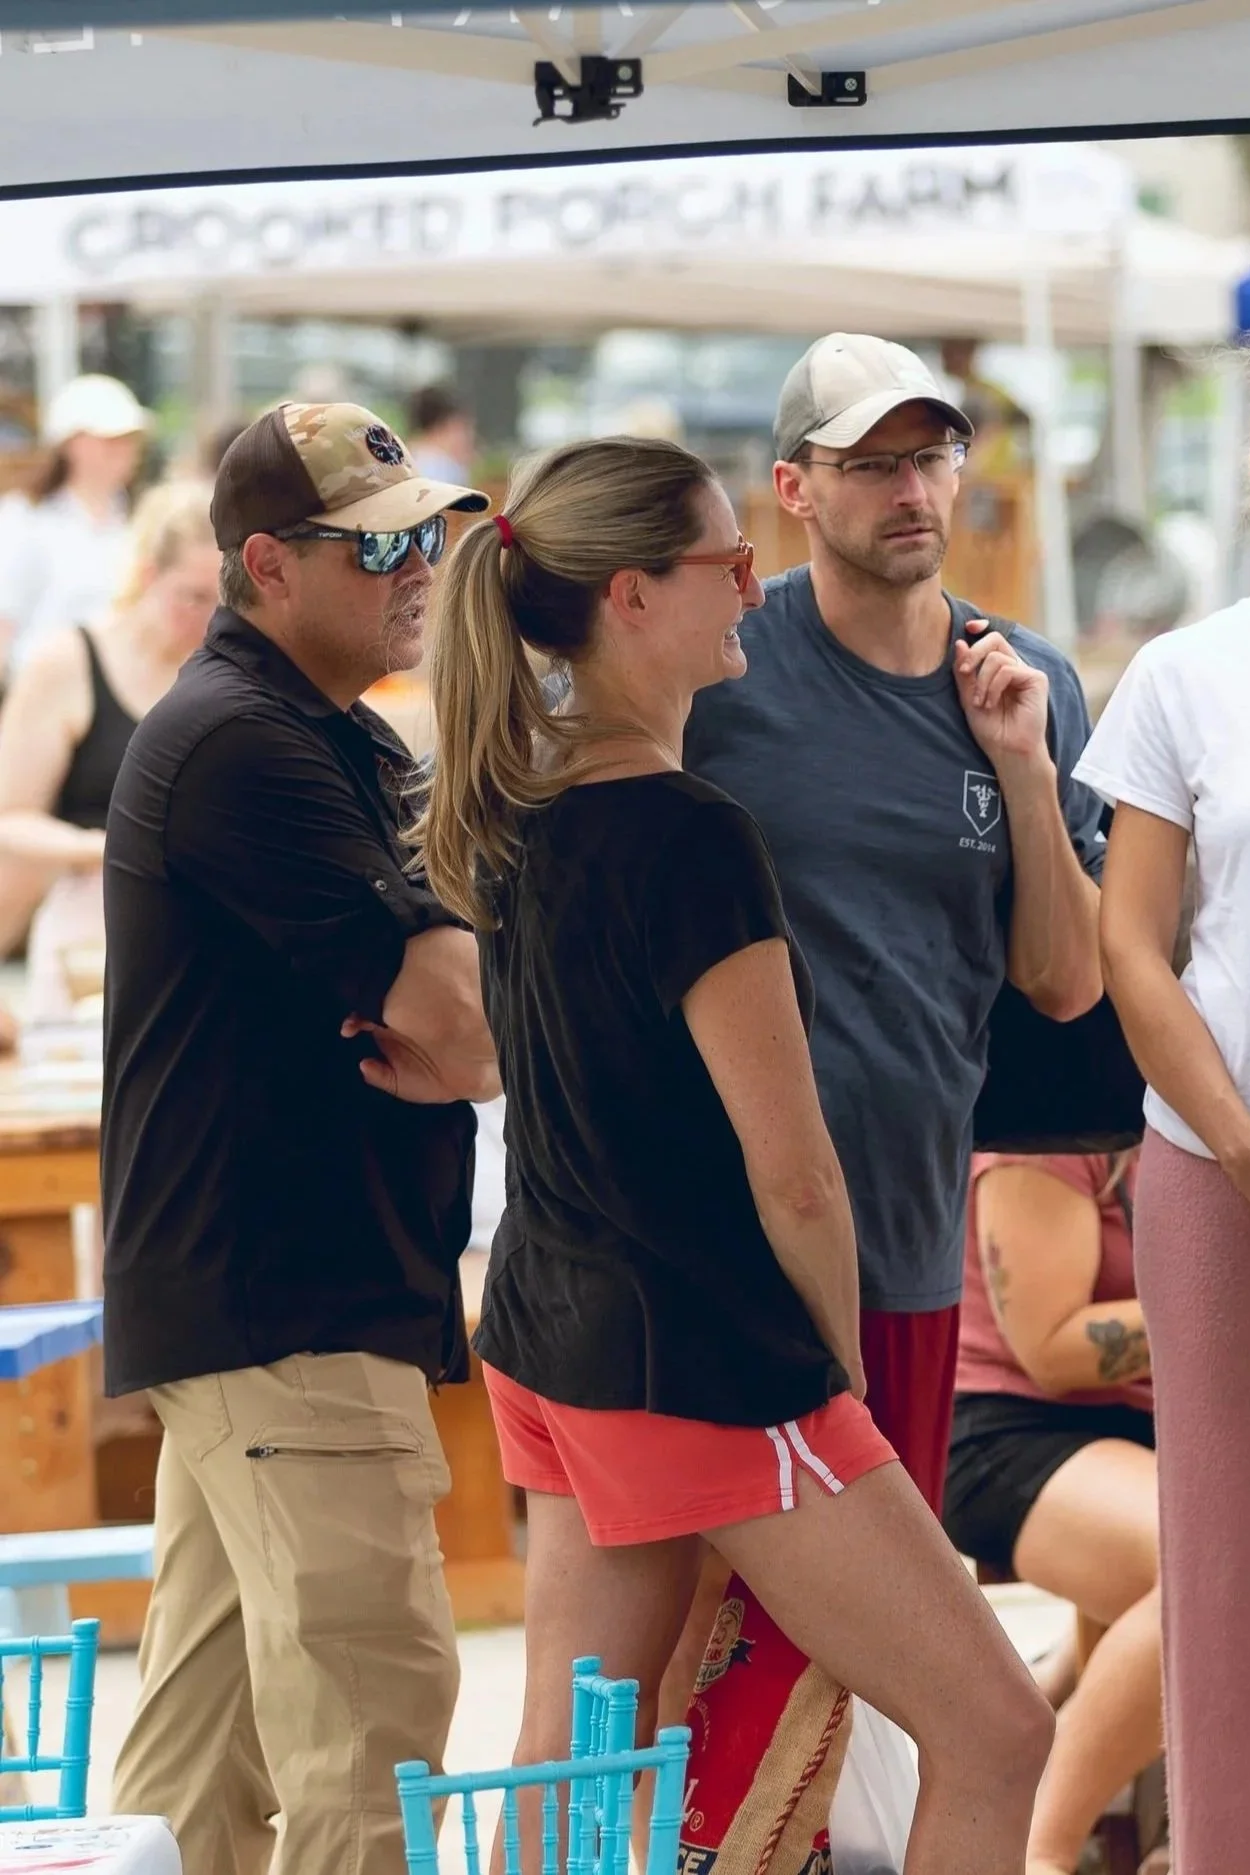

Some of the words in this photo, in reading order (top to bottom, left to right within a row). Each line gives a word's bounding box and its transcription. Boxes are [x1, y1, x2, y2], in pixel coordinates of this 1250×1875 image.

[64, 193, 461, 272] CROOKED
[495, 172, 782, 244] PORCH
[812, 160, 1017, 225] FARM
[959, 837, 976, 848] EST.
